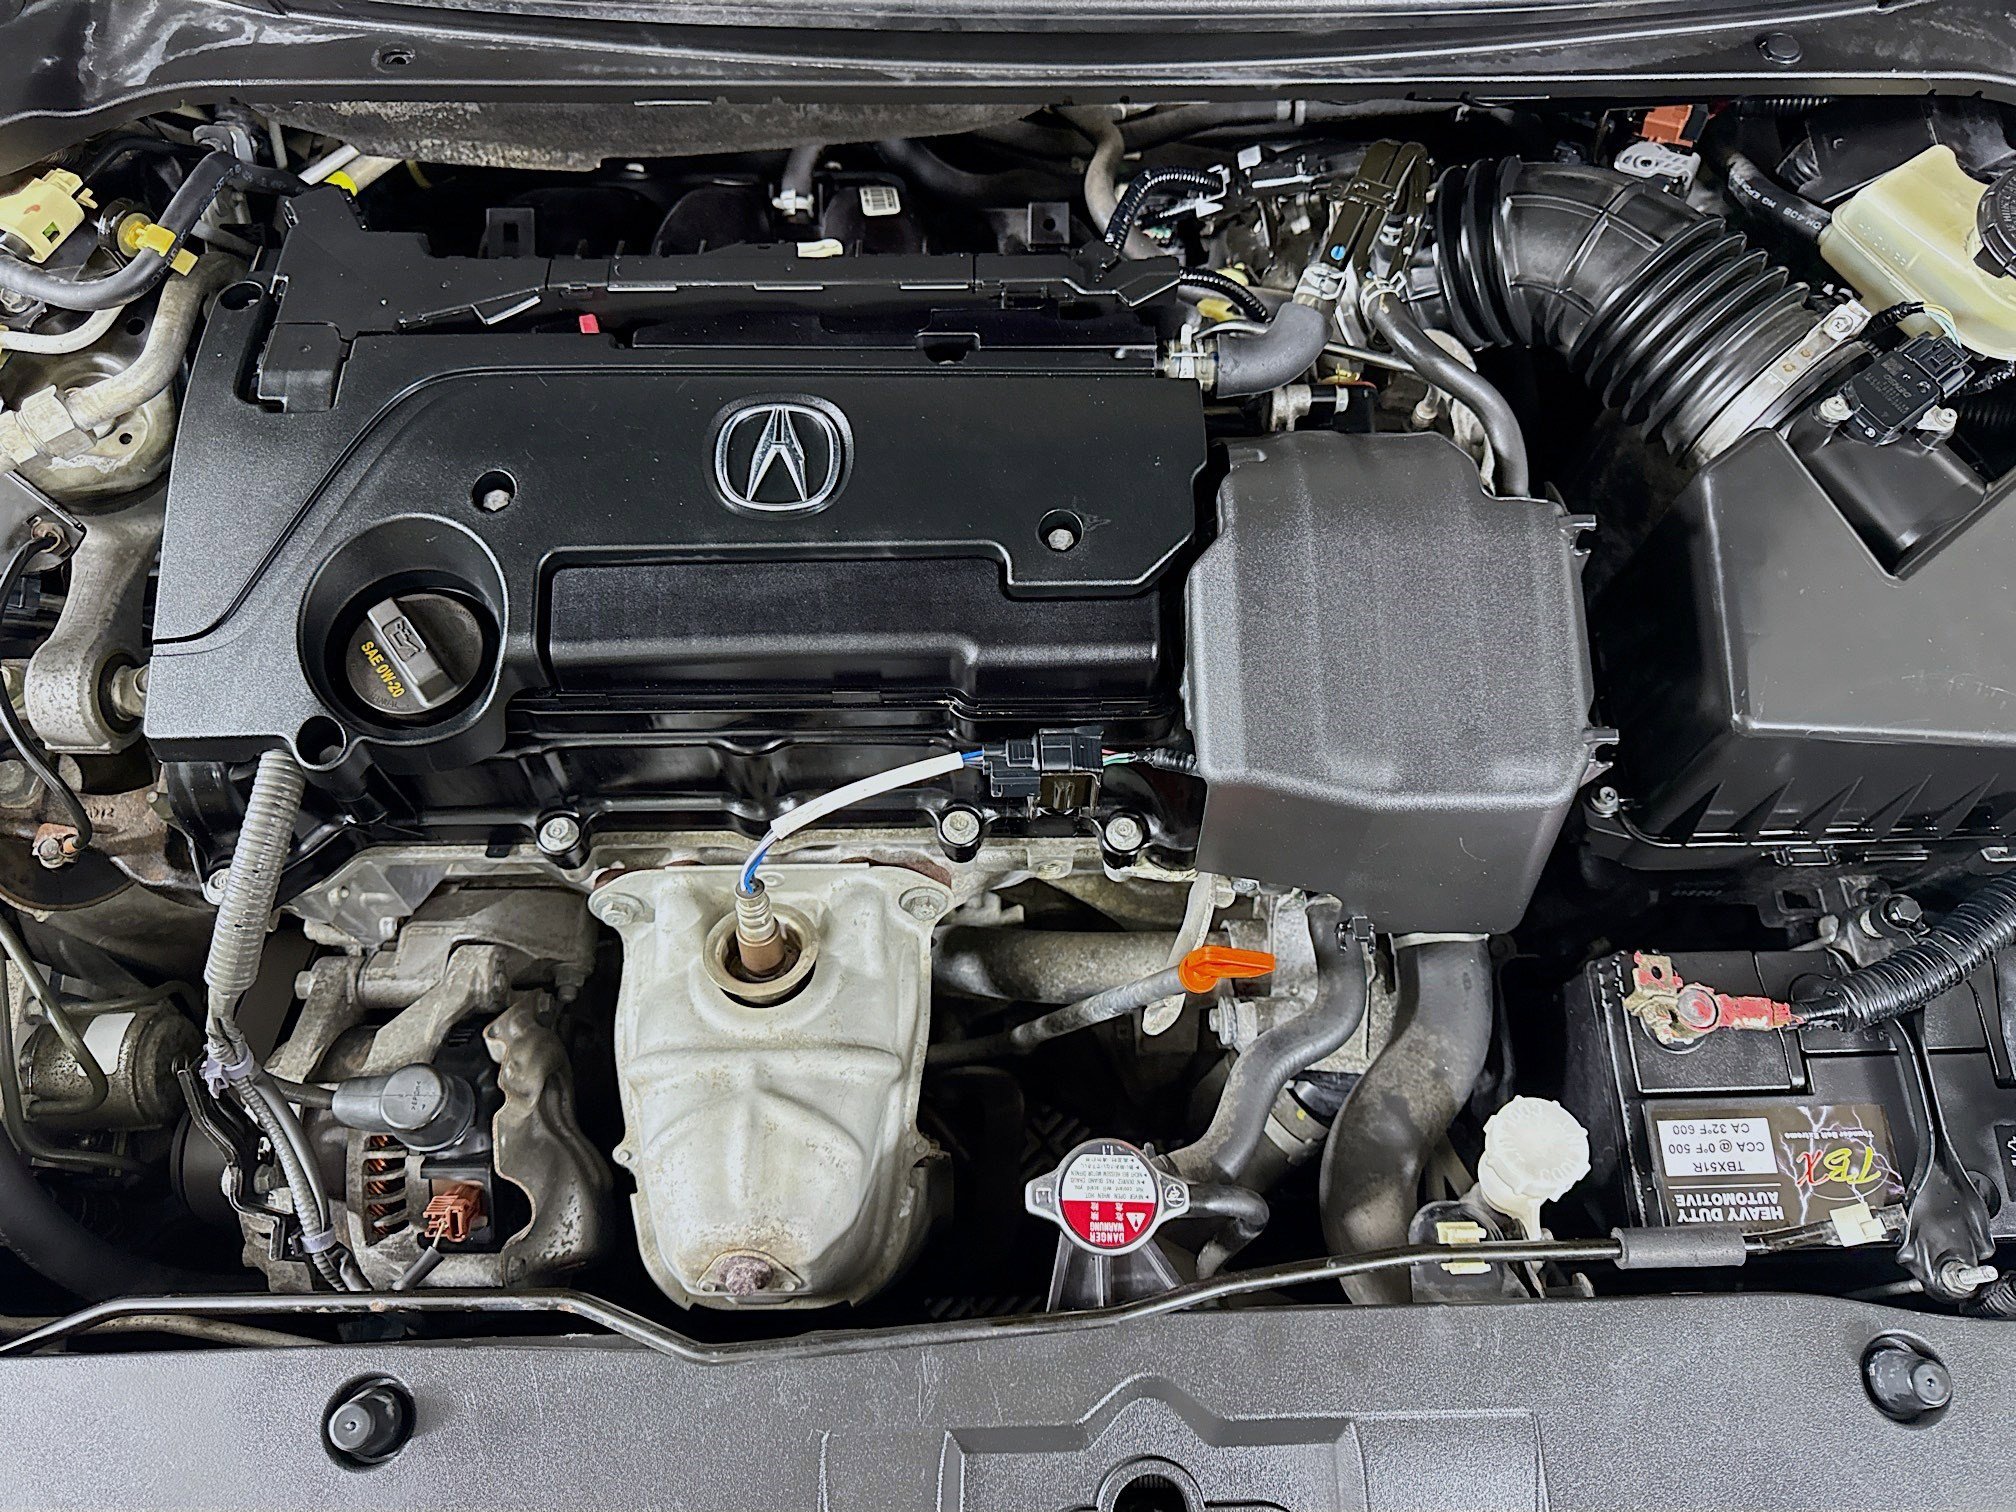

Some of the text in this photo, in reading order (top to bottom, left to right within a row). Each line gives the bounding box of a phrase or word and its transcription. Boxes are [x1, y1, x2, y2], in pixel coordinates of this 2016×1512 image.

[1884, 374, 1912, 399] DENSO
[361, 641, 406, 698] SAE 0W-20
[1672, 1124, 1695, 1135] 600
[1731, 1123, 1750, 1134] CA
[1784, 1130, 1874, 1140] Thunder Bolt Extreme
[1668, 1143, 1691, 1154] 500
[1736, 1141, 1765, 1153] CCA
[1692, 1160, 1745, 1172] TBX51R
[1794, 1145, 1882, 1188] TBX
[1674, 1191, 1779, 1207] AUTOMOTIVE
[1676, 1205, 1785, 1223] HEAVY DUTY
[1090, 1222, 1124, 1232] WARNUNG
[1090, 1232, 1124, 1243] DANGER
